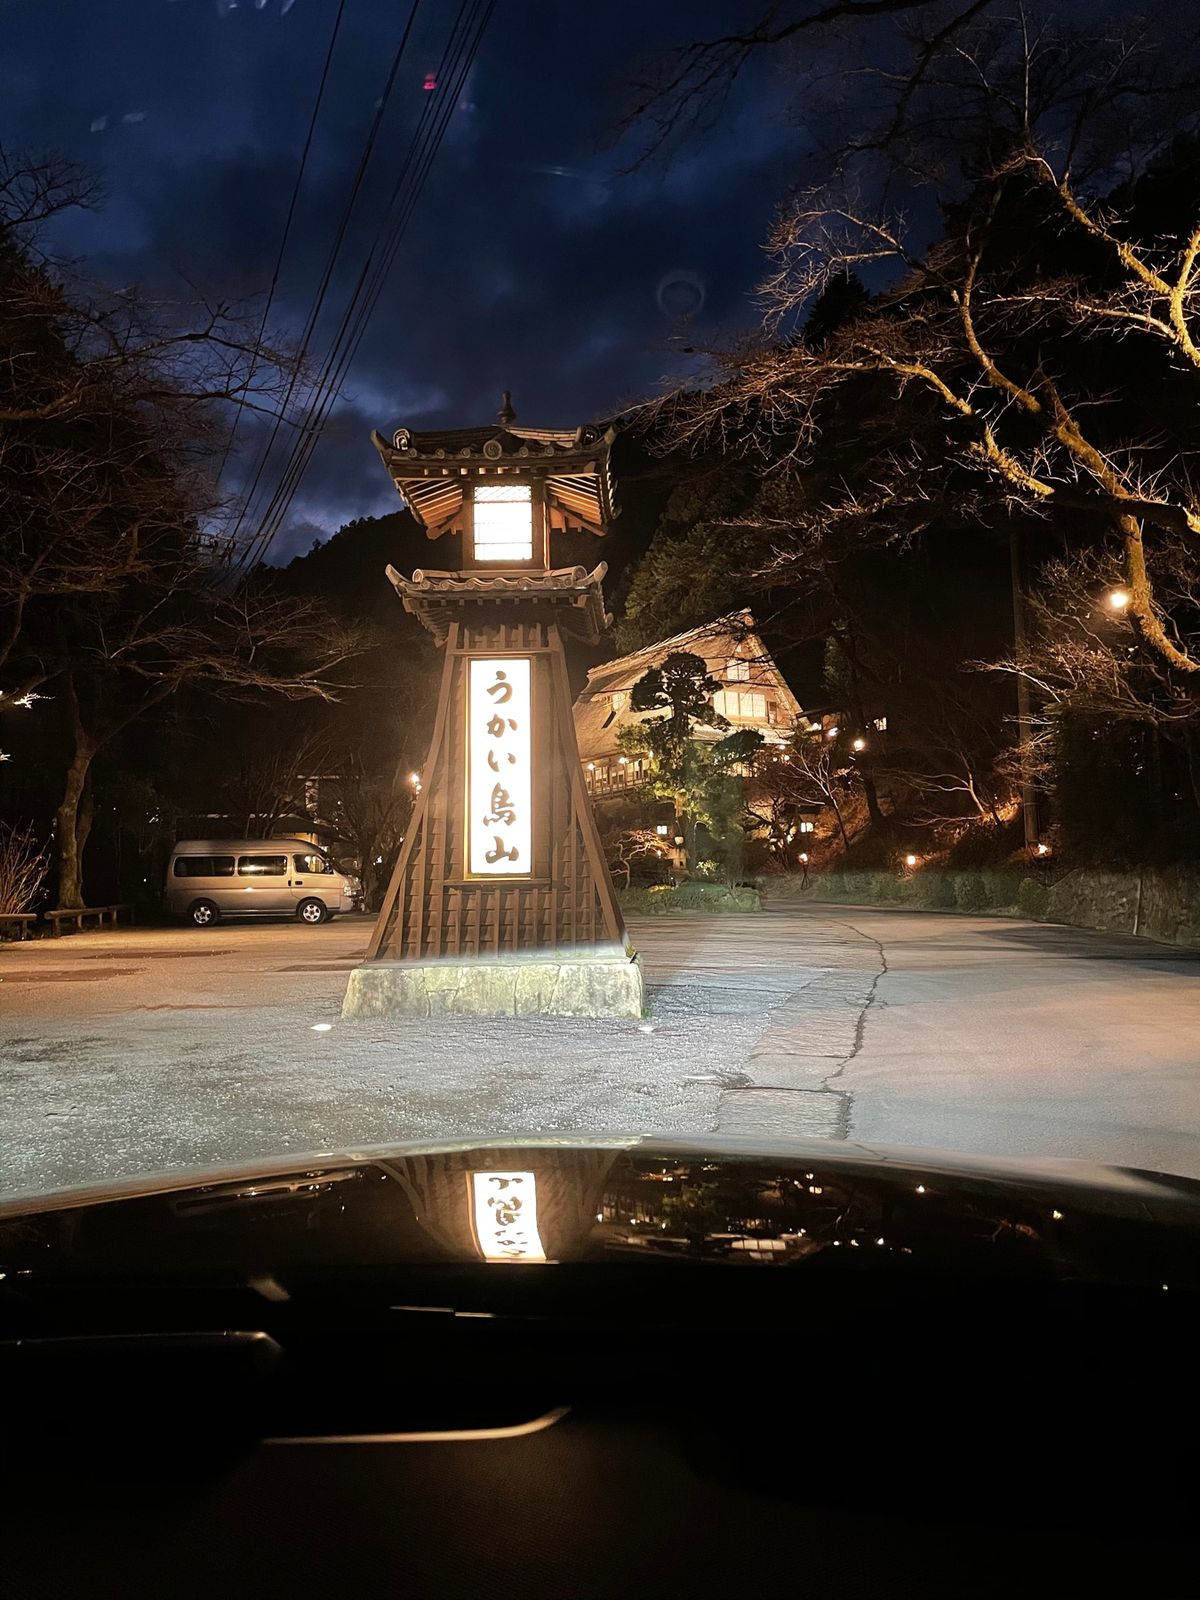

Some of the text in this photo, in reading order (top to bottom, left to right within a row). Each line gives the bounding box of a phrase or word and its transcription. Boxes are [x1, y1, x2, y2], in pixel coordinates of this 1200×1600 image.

[483, 670, 519, 864] うかい鳥山
